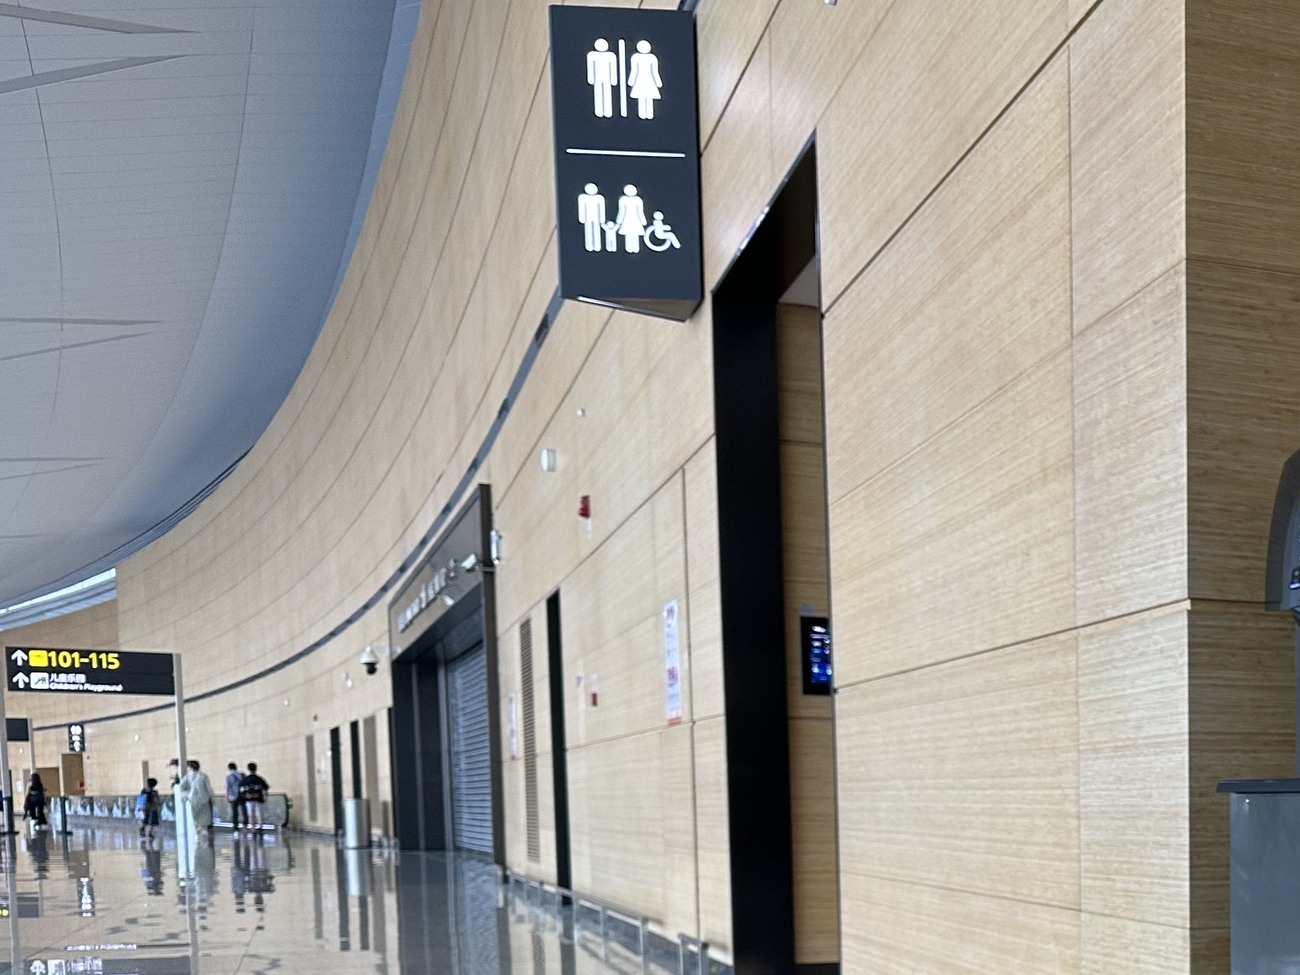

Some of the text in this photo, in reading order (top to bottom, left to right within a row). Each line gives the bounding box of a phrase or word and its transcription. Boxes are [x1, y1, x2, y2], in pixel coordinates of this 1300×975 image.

[48, 650, 121, 670] 101-115
[49, 682, 124, 693] Children's Playground
